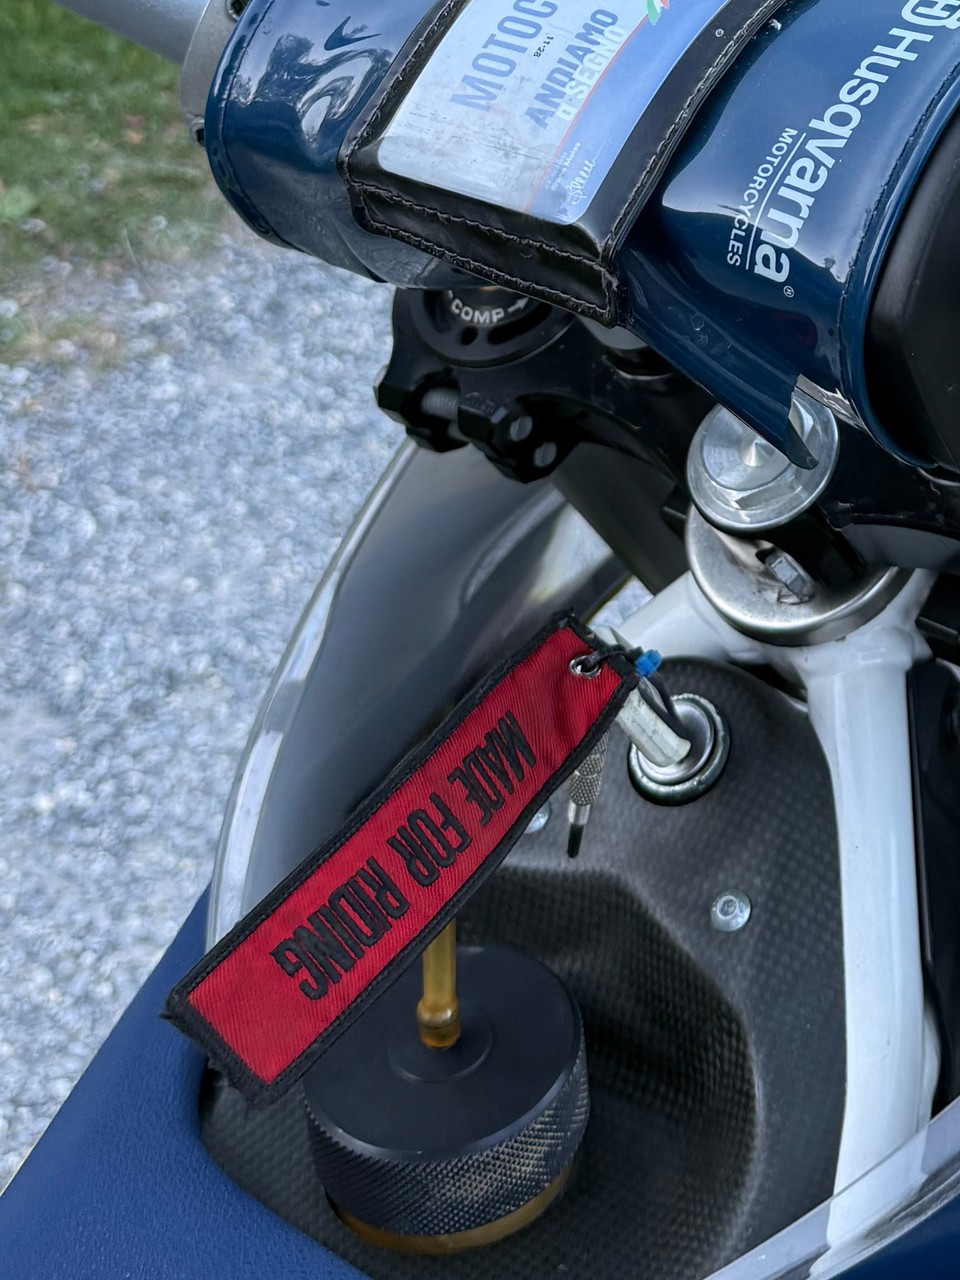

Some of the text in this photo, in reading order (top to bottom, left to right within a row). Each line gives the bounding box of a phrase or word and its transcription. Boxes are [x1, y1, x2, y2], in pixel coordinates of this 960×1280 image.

[525, 8, 619, 130] ANDIAMO
[726, 127, 799, 267] MOTORCYCLES
[451, 300, 506, 324] COMP
[269, 710, 538, 1002] MADE FOR RIDING
